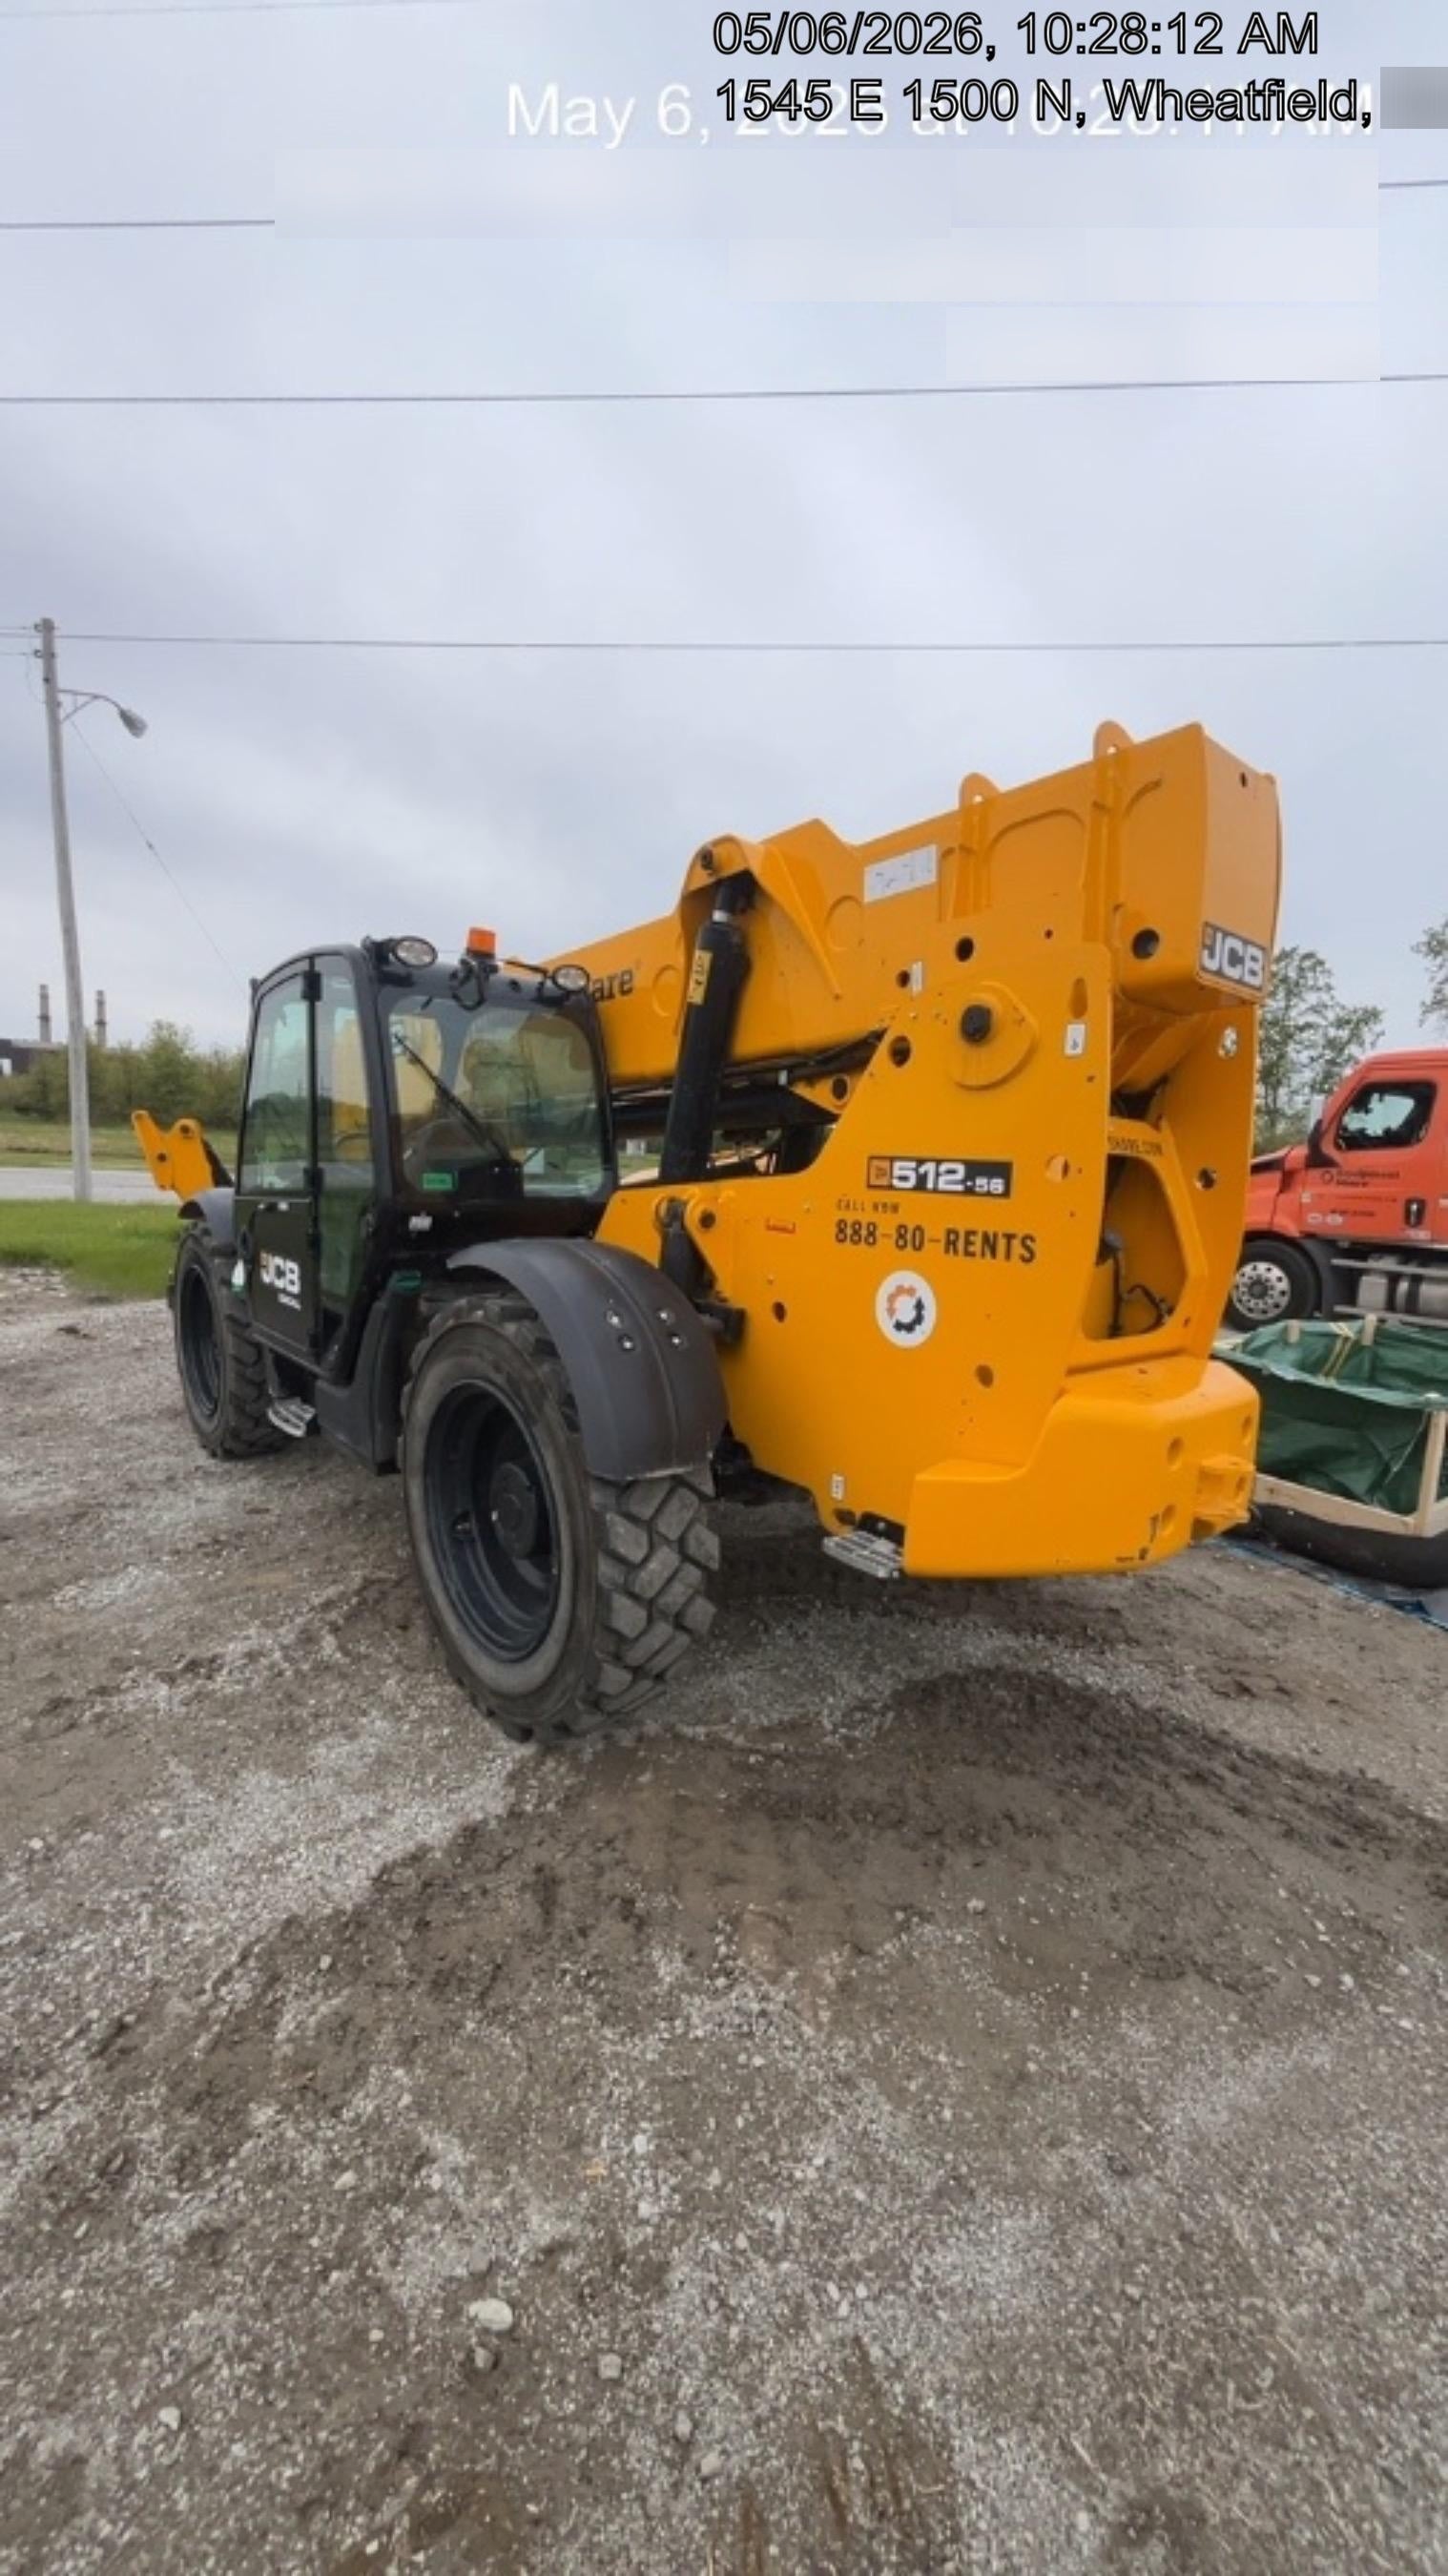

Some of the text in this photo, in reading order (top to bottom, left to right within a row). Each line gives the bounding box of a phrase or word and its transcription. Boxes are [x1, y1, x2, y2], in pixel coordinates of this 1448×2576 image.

[1201, 929, 1264, 987] JCB
[835, 1218, 1037, 1263] 888-80-RENTS
[259, 1250, 301, 1295] JCB
